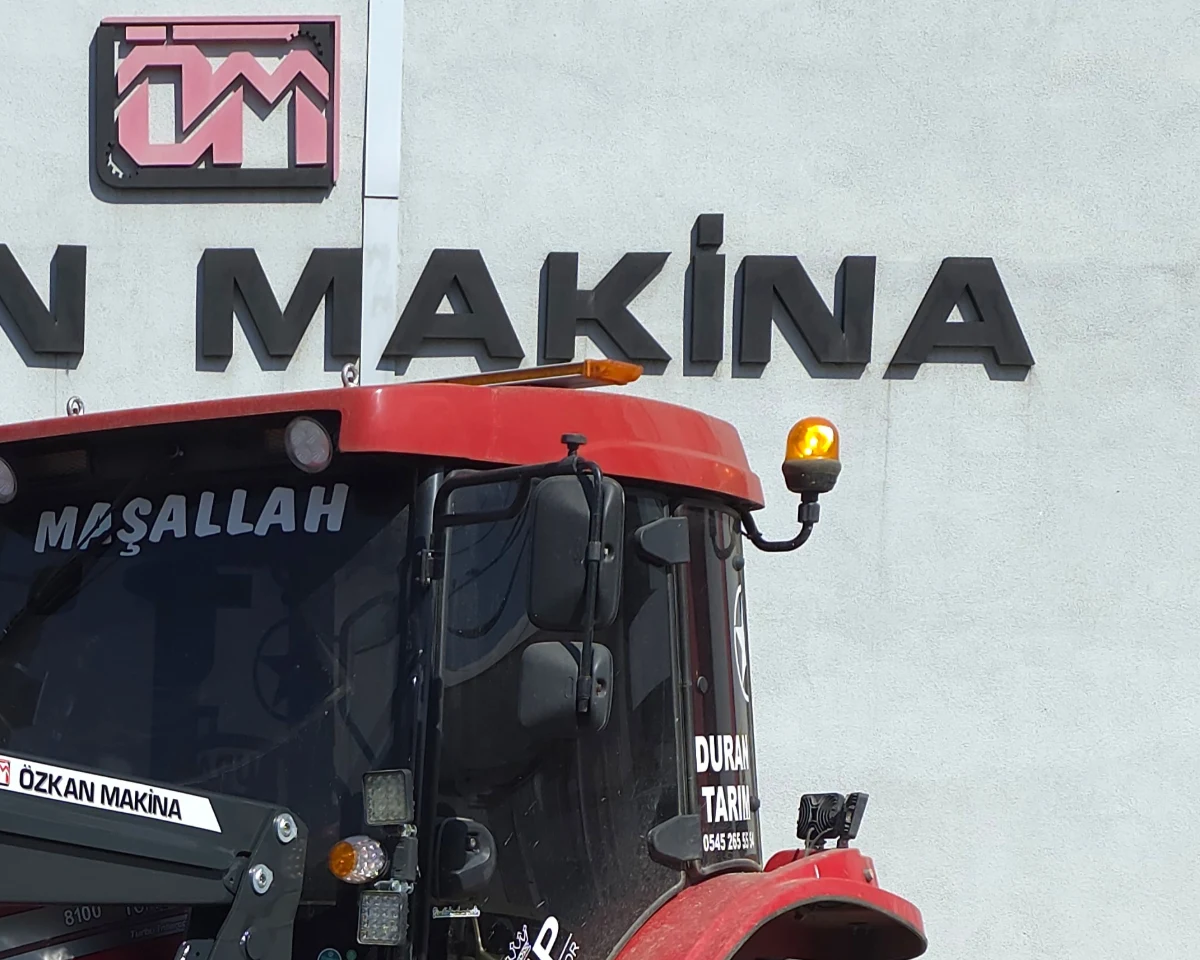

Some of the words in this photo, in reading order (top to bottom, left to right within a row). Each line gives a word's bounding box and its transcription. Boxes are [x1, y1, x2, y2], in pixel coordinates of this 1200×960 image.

[197, 213, 1035, 381] MAKİNA
[34, 483, 349, 557] MAŞALLAH
[695, 735, 750, 773] DURAN
[19, 764, 94, 803] ÖZKAN
[100, 784, 182, 820] MAKİNA
[703, 833, 726, 852] 0545
[727, 832, 742, 850] 265
[64, 905, 102, 925] 8100
